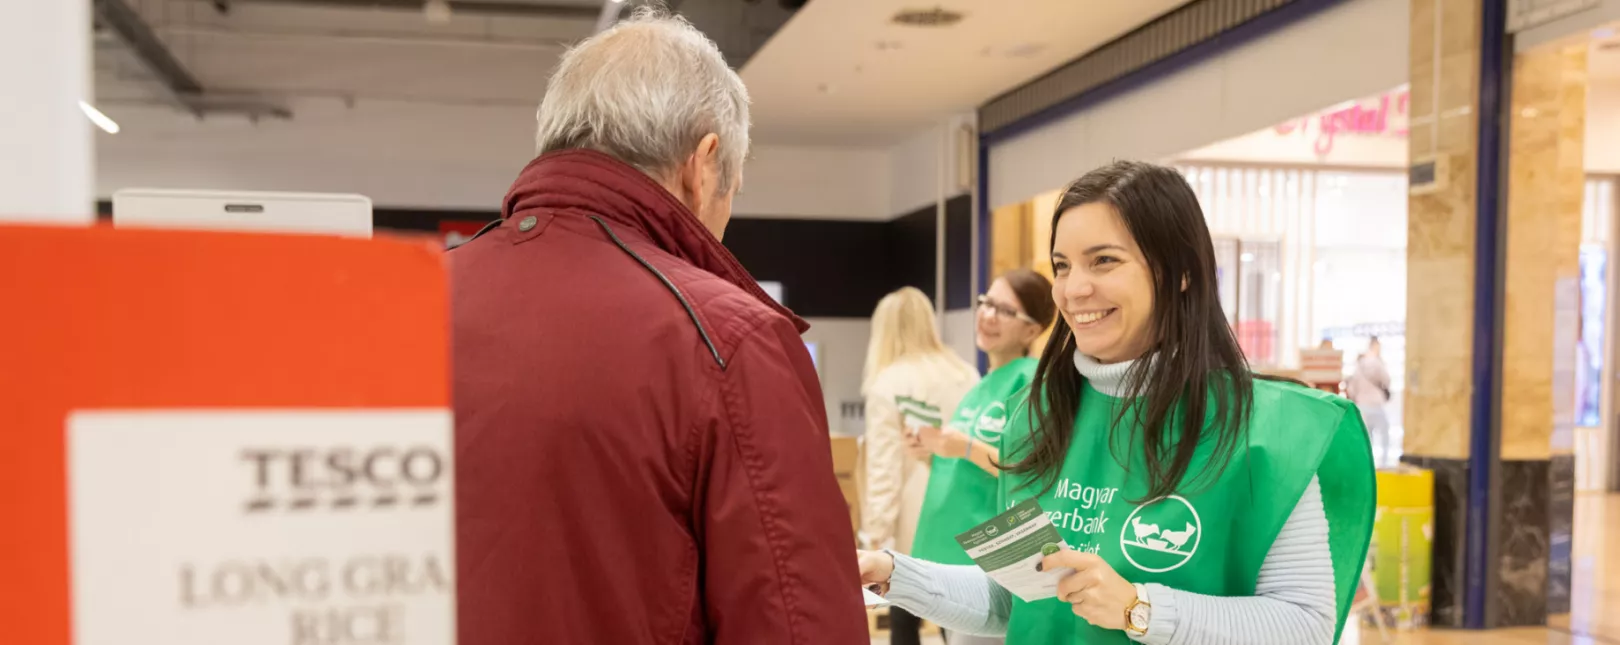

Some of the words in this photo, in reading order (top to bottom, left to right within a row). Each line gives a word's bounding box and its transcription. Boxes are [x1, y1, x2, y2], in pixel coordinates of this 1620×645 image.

[238, 447, 443, 490] TESCO
[1054, 478, 1118, 510] Magyar
[178, 561, 331, 607] LONG
[342, 554, 453, 597] GRA
[290, 606, 402, 645] RICE
